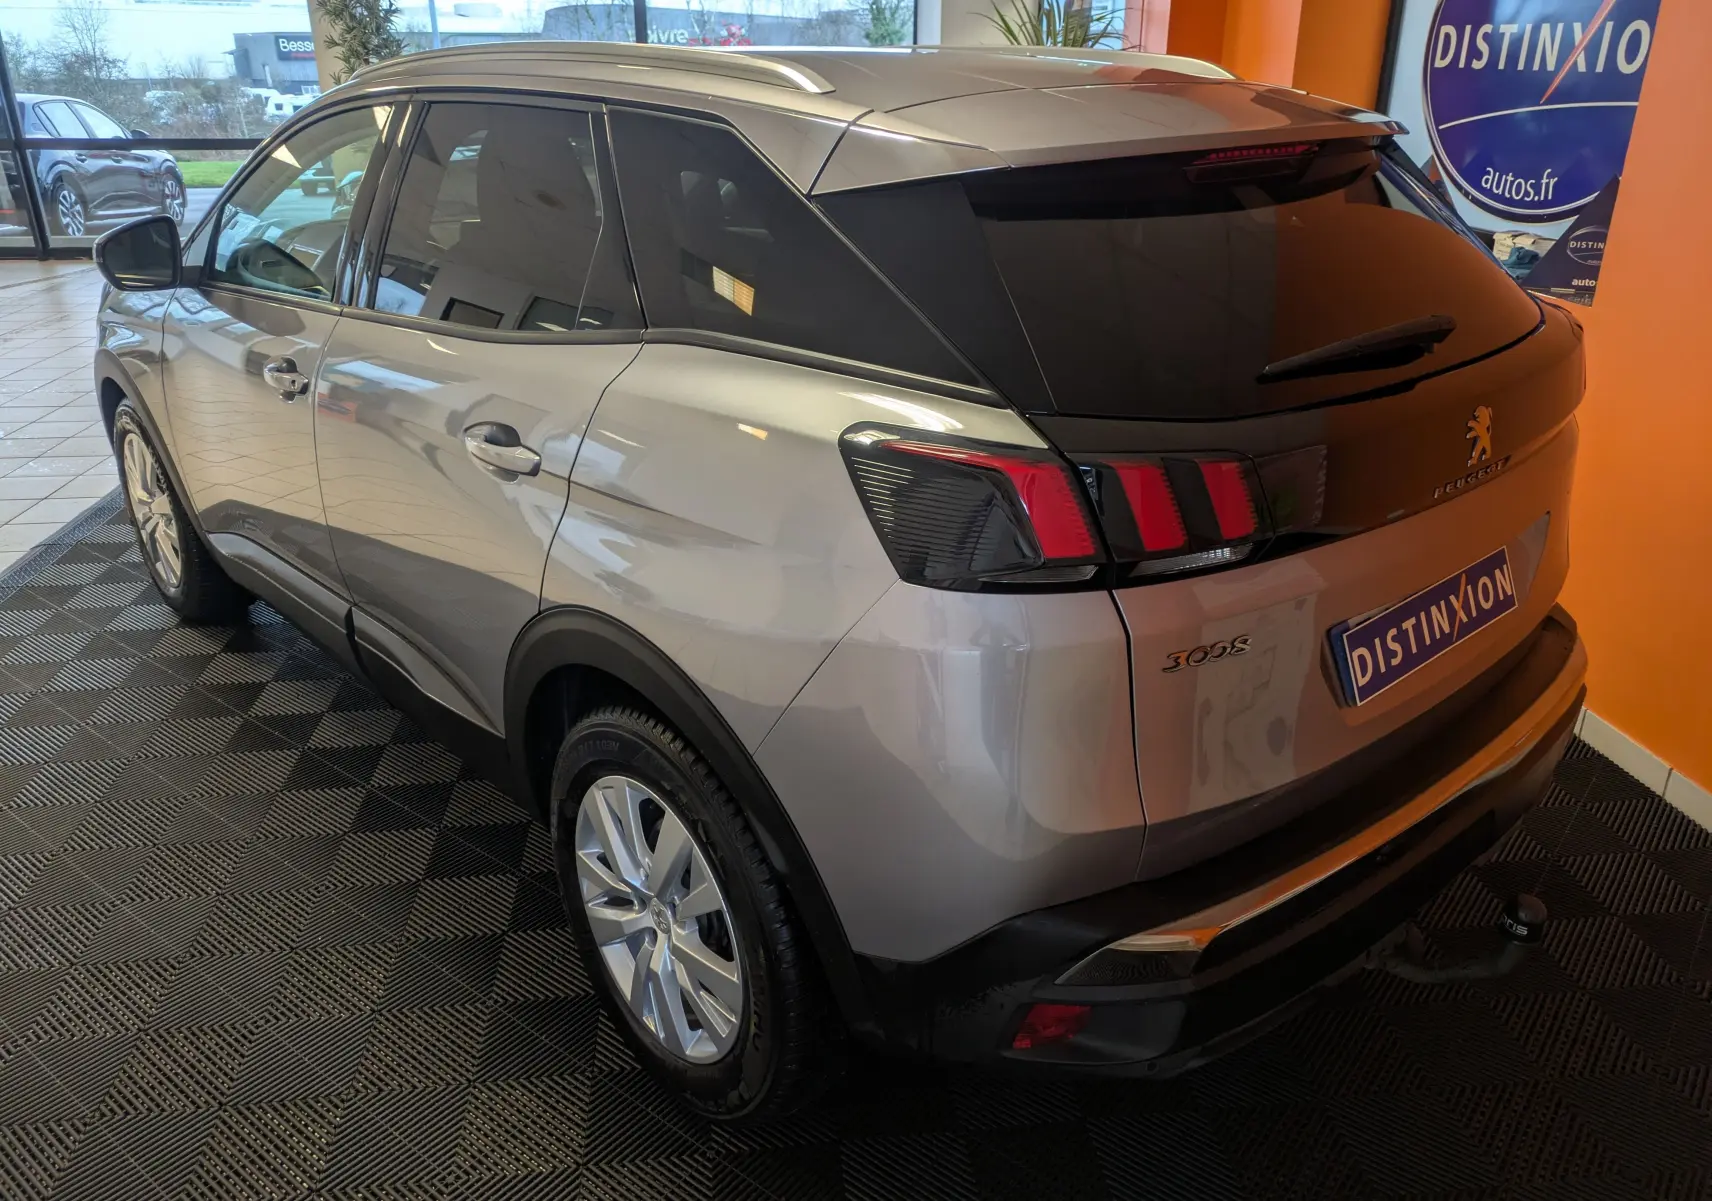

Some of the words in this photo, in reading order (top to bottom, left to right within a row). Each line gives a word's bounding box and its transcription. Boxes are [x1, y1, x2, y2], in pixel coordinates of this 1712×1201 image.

[278, 38, 315, 52] Bess
[1481, 167, 1558, 202] autos.fr
[1433, 457, 1506, 499] PEUGEOT
[1351, 564, 1513, 687] DISTINXION
[1161, 633, 1253, 674] 3008
